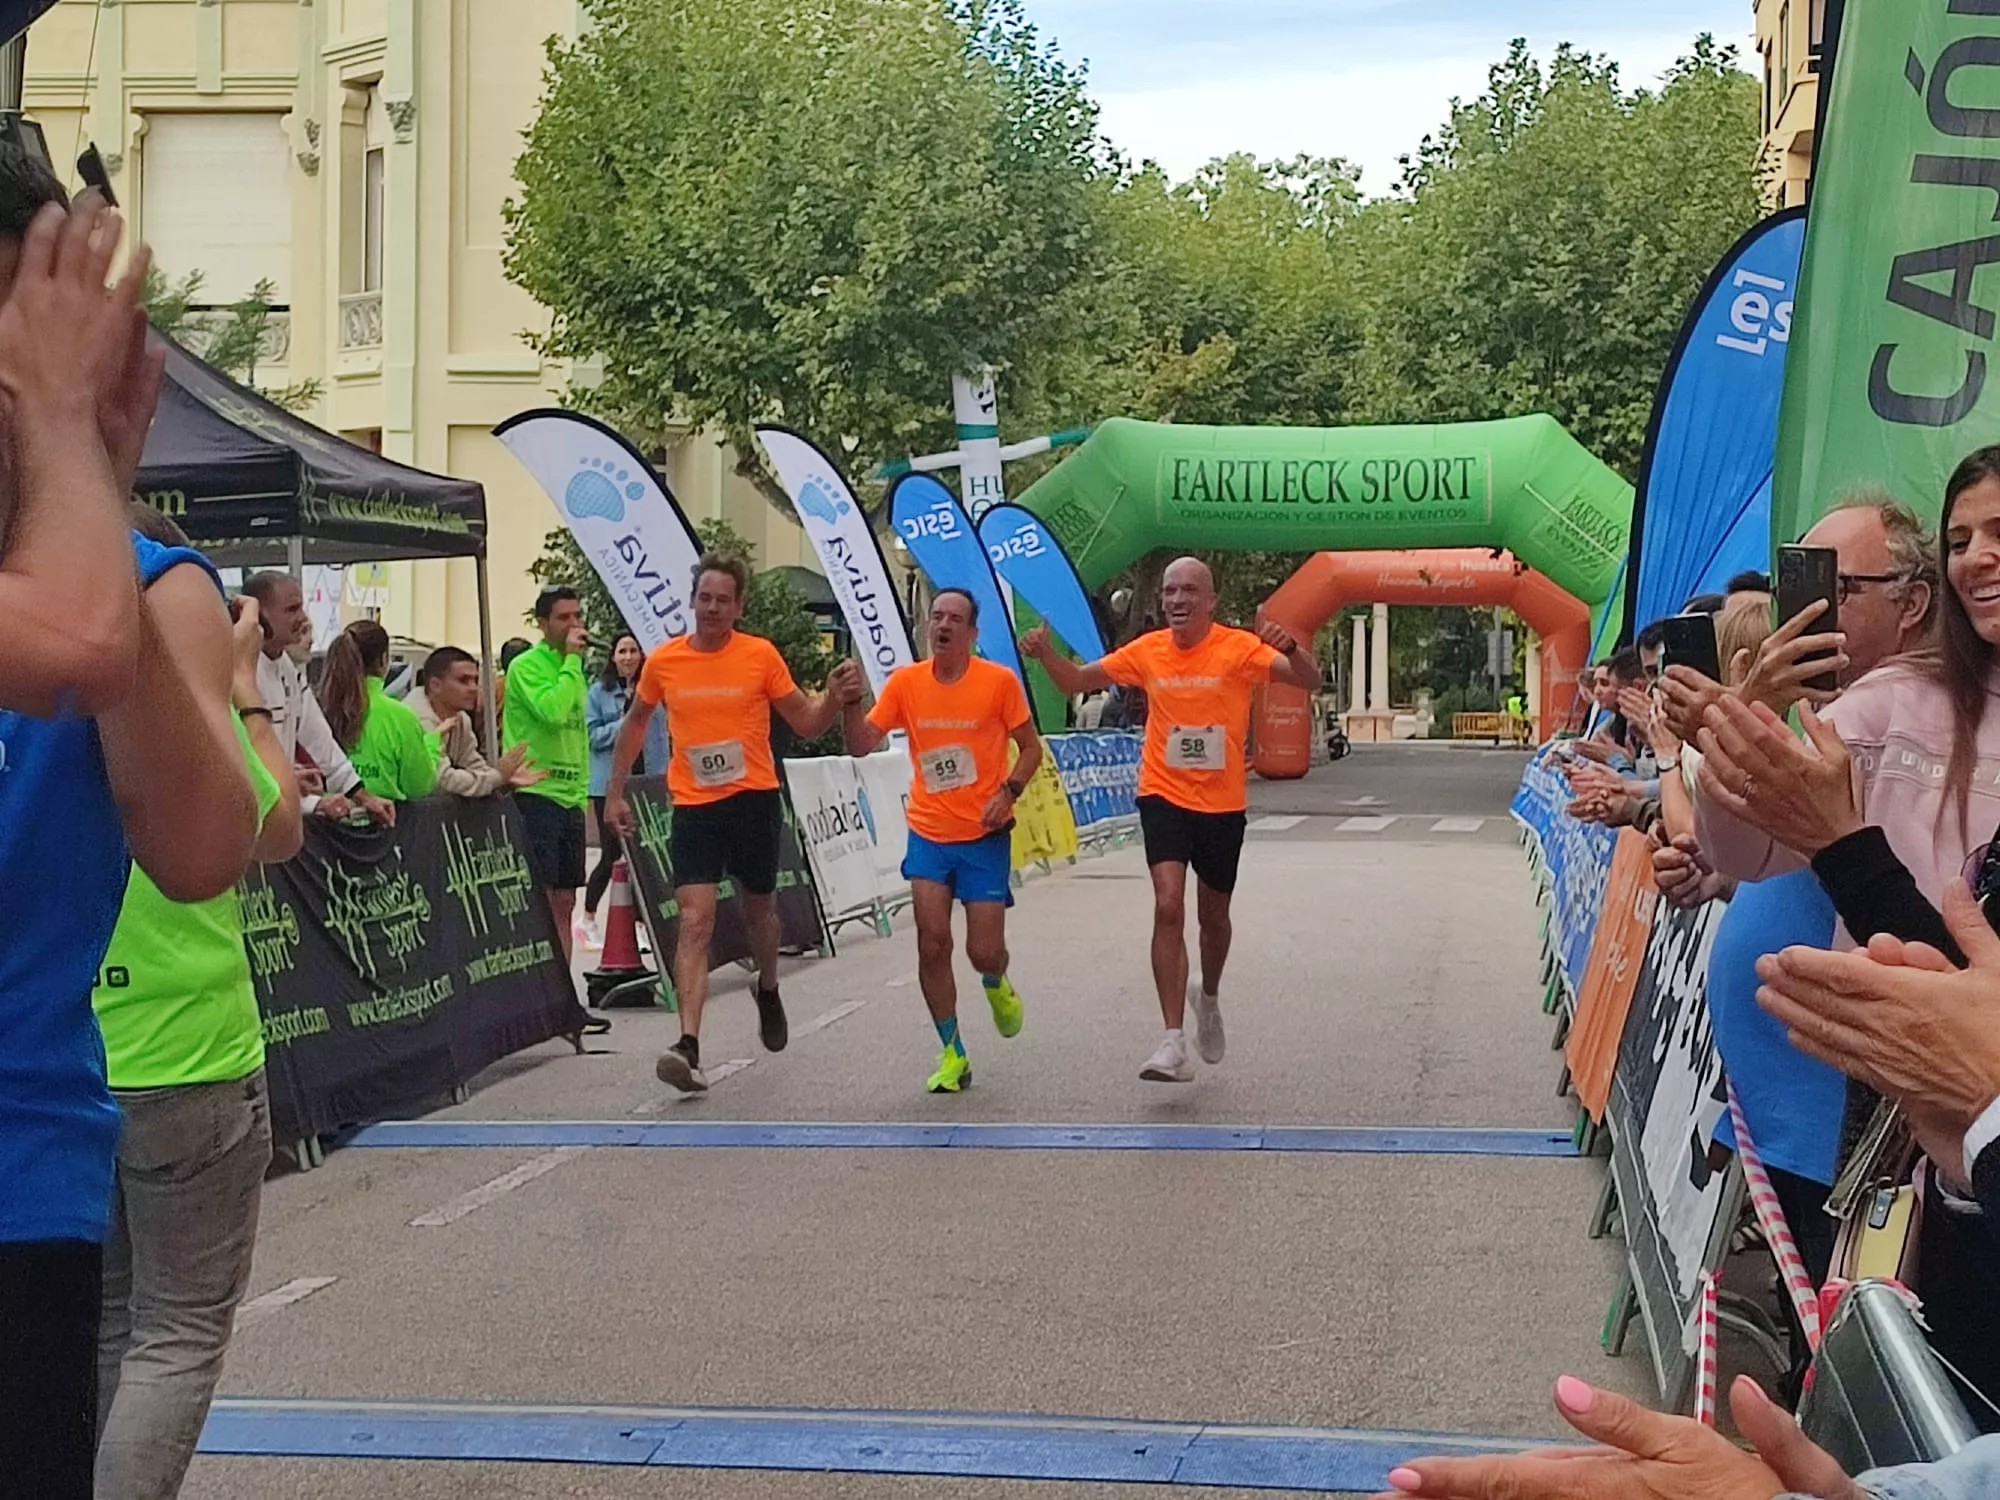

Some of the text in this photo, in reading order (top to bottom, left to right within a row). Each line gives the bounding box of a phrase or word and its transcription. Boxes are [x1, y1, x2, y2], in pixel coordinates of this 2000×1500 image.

[1868, 0, 2000, 427] CAJÓ
[1171, 456, 1477, 504] FARTLECK SPORT
[1180, 738, 1205, 753] 58
[702, 754, 726, 770] 60
[935, 759, 957, 776] 59
